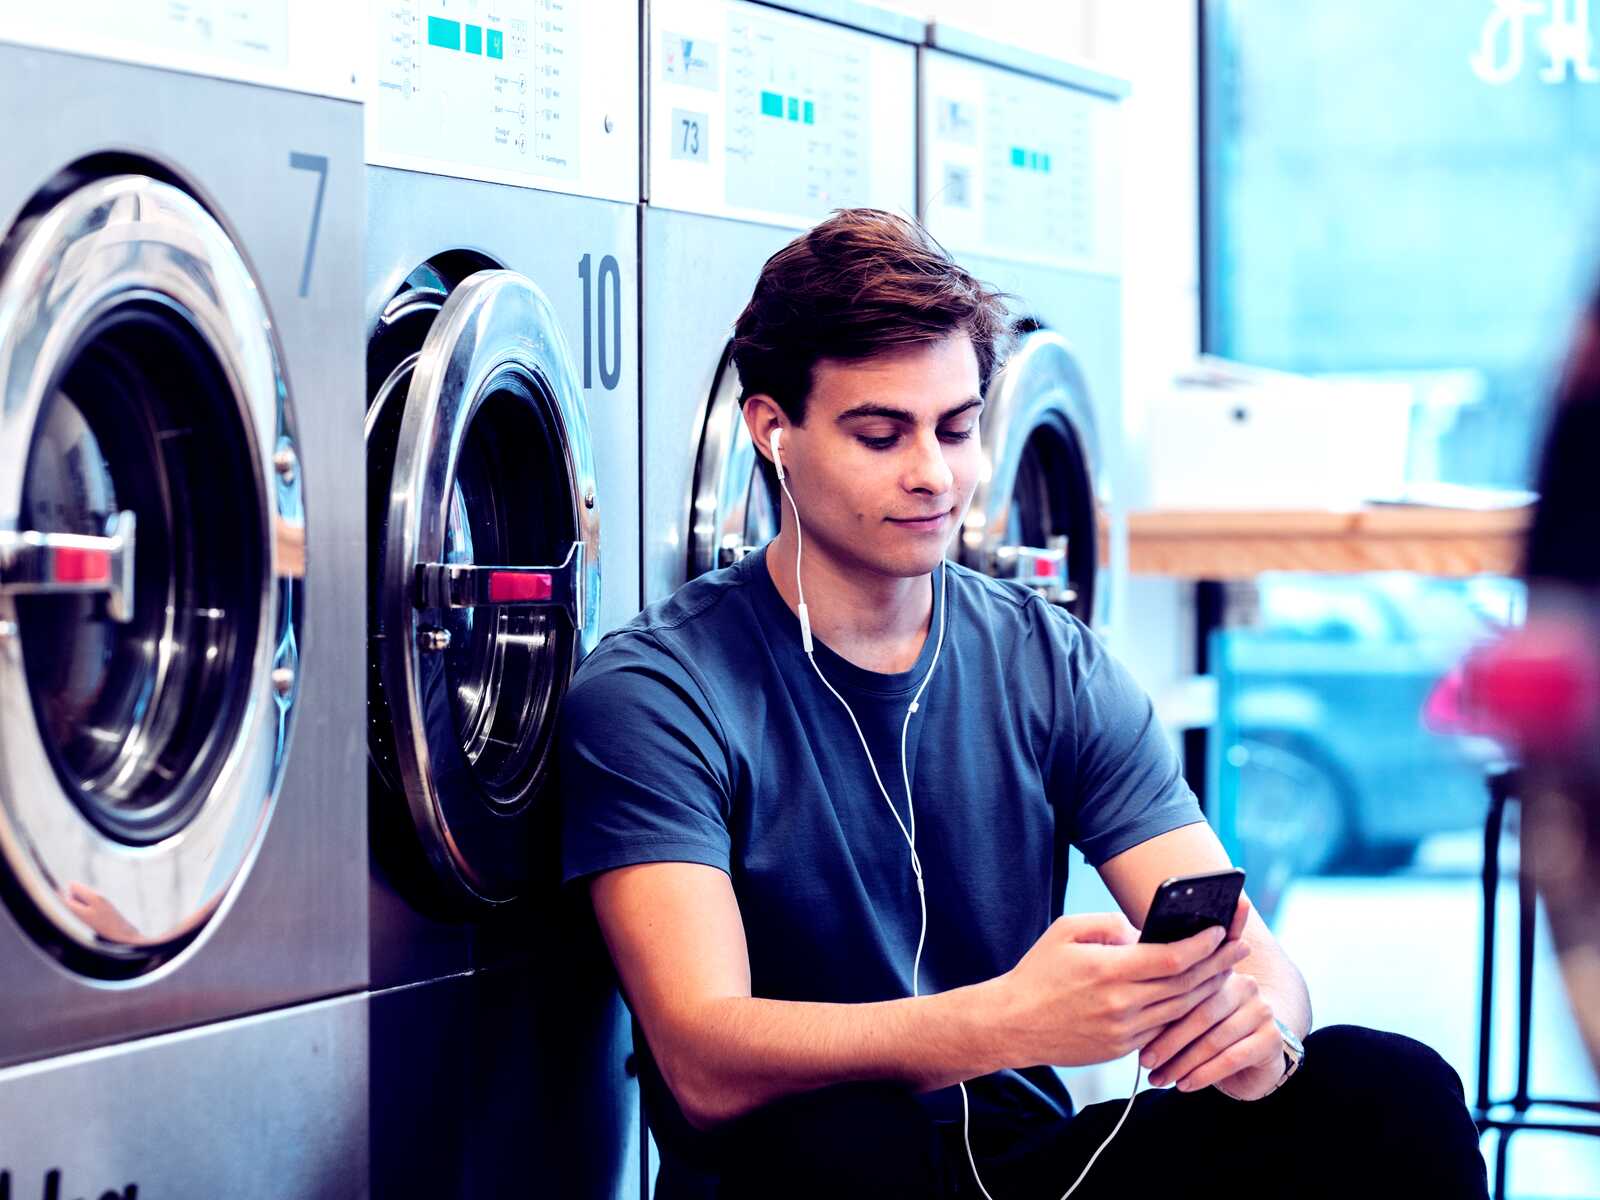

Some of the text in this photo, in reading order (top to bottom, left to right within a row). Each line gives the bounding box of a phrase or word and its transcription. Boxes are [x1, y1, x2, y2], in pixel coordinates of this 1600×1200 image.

[682, 119, 699, 155] 73
[289, 151, 329, 299] 7
[578, 253, 622, 391] 10
